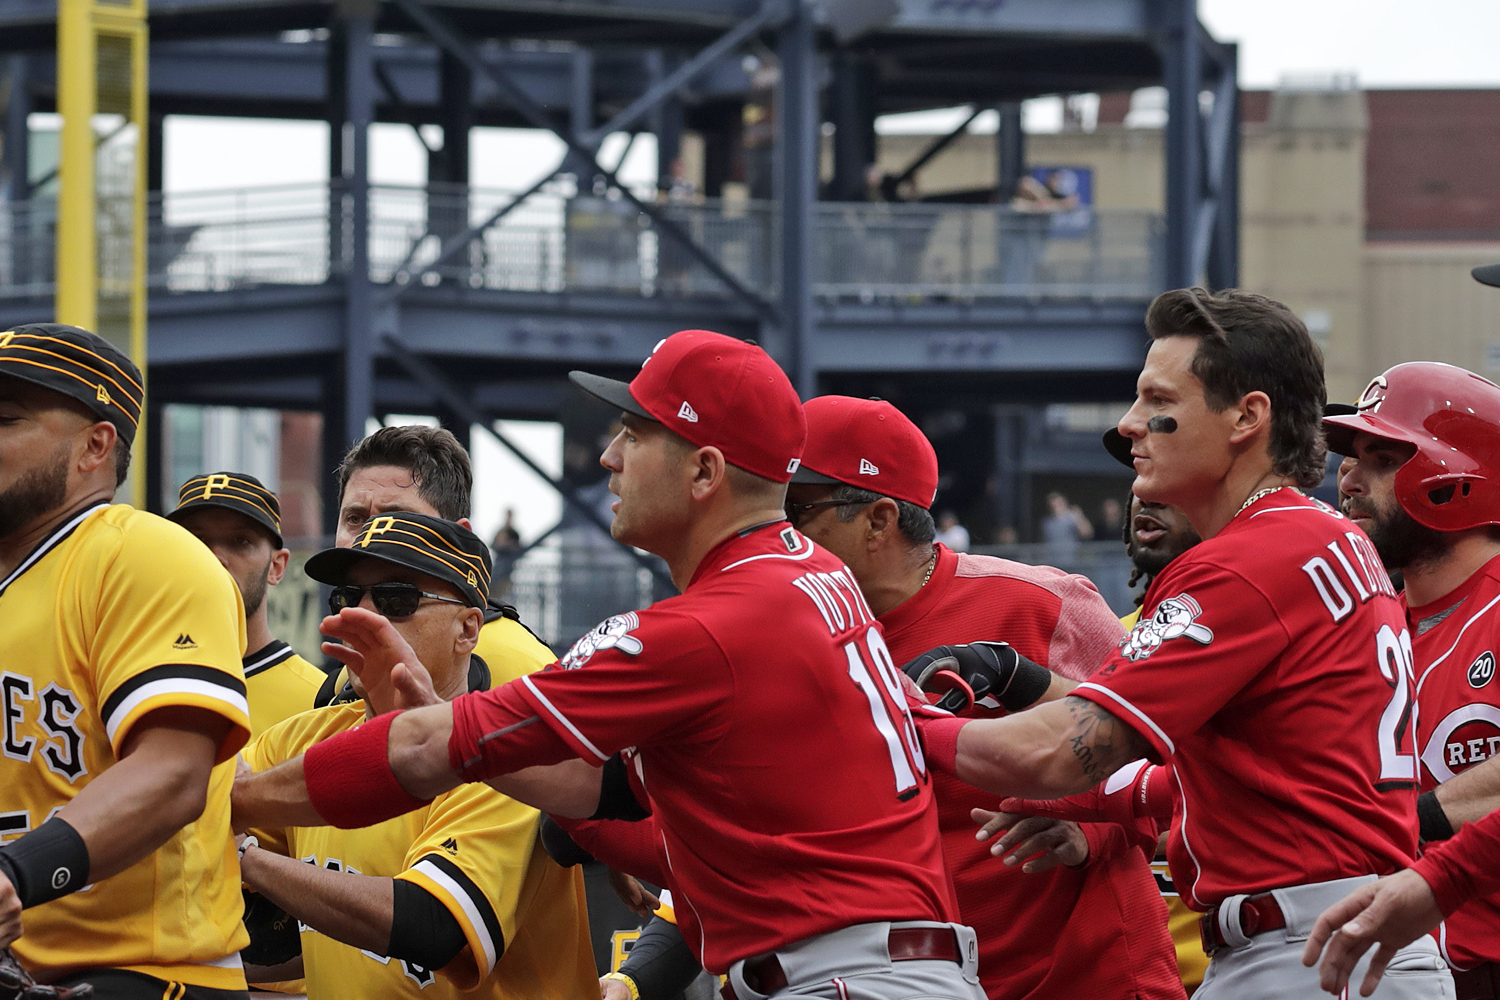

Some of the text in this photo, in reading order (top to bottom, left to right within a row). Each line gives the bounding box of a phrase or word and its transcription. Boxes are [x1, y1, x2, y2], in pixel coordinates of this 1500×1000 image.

[203, 474, 229, 500] P
[361, 516, 395, 548] P
[1471, 657, 1492, 679] 20
